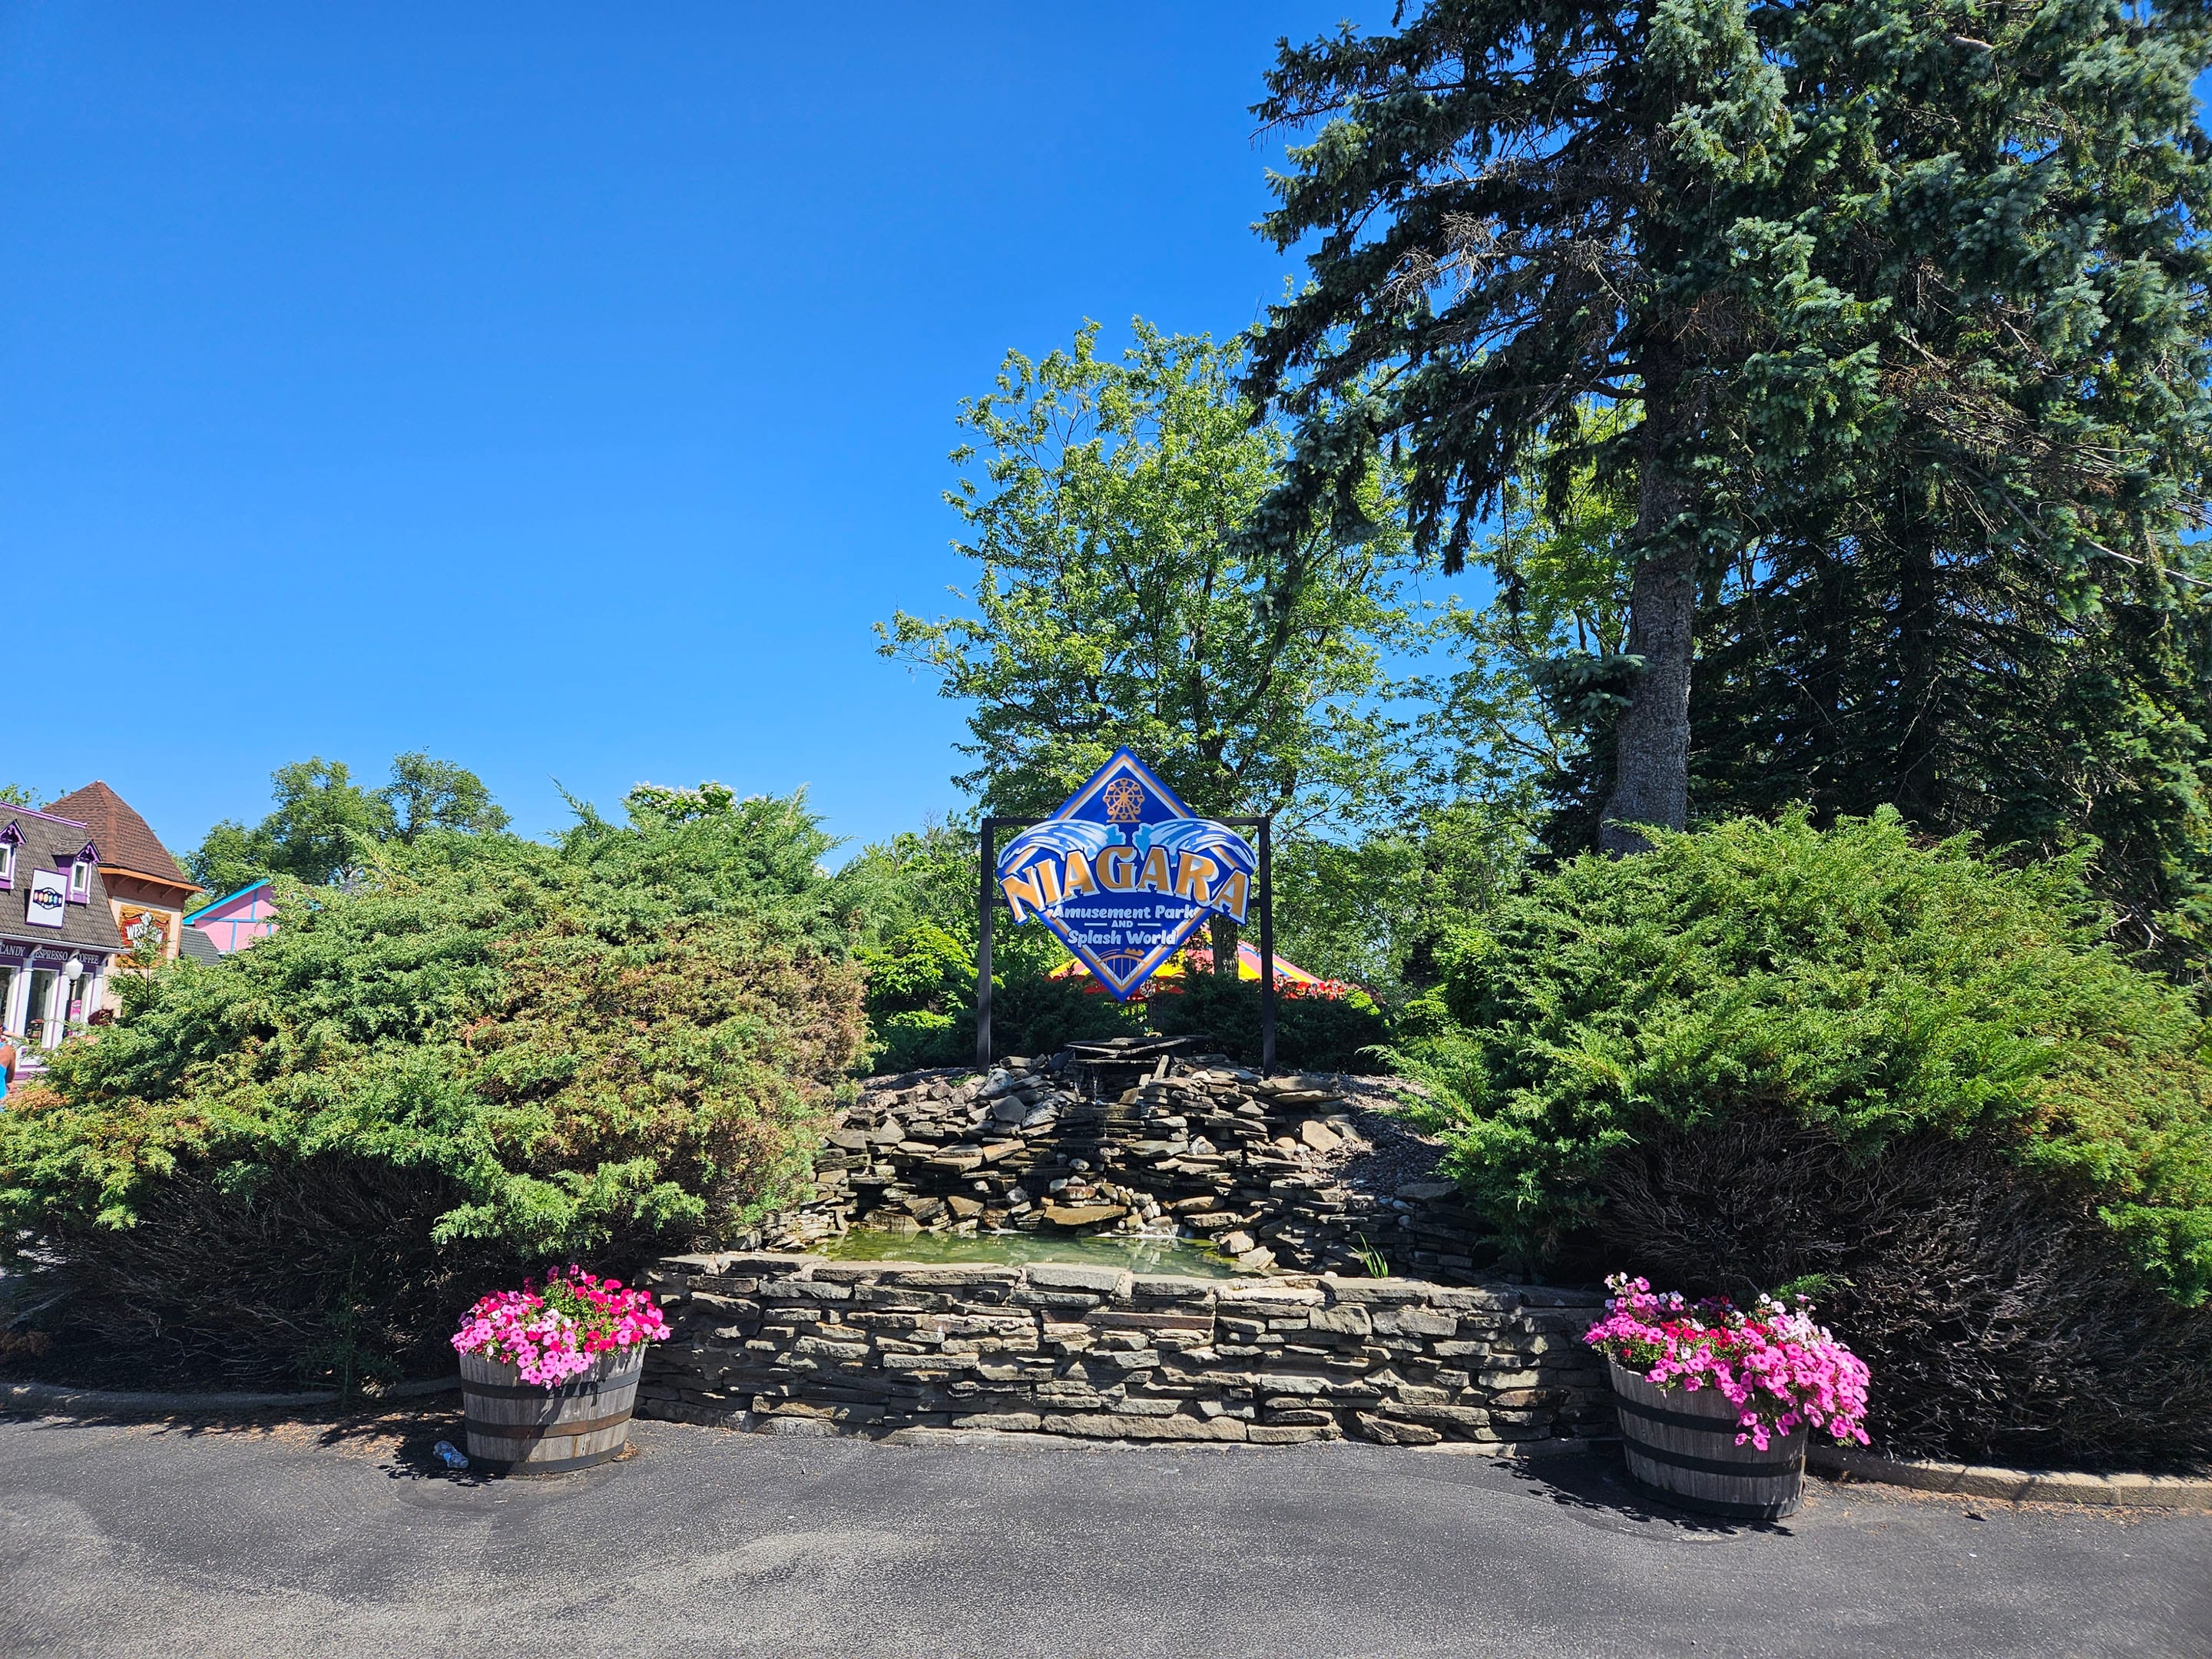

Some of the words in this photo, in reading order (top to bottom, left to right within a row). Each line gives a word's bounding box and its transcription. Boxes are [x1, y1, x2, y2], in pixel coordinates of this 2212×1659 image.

[1000, 846, 1250, 923] NIAGARA
[1052, 906, 1151, 919] Amusement
[1155, 904, 1195, 919] Park
[1068, 929, 1121, 947] Splash
[1126, 929, 1177, 945] World
[0, 944, 25, 957] CANDY
[35, 949, 68, 962] ESPRESSO
